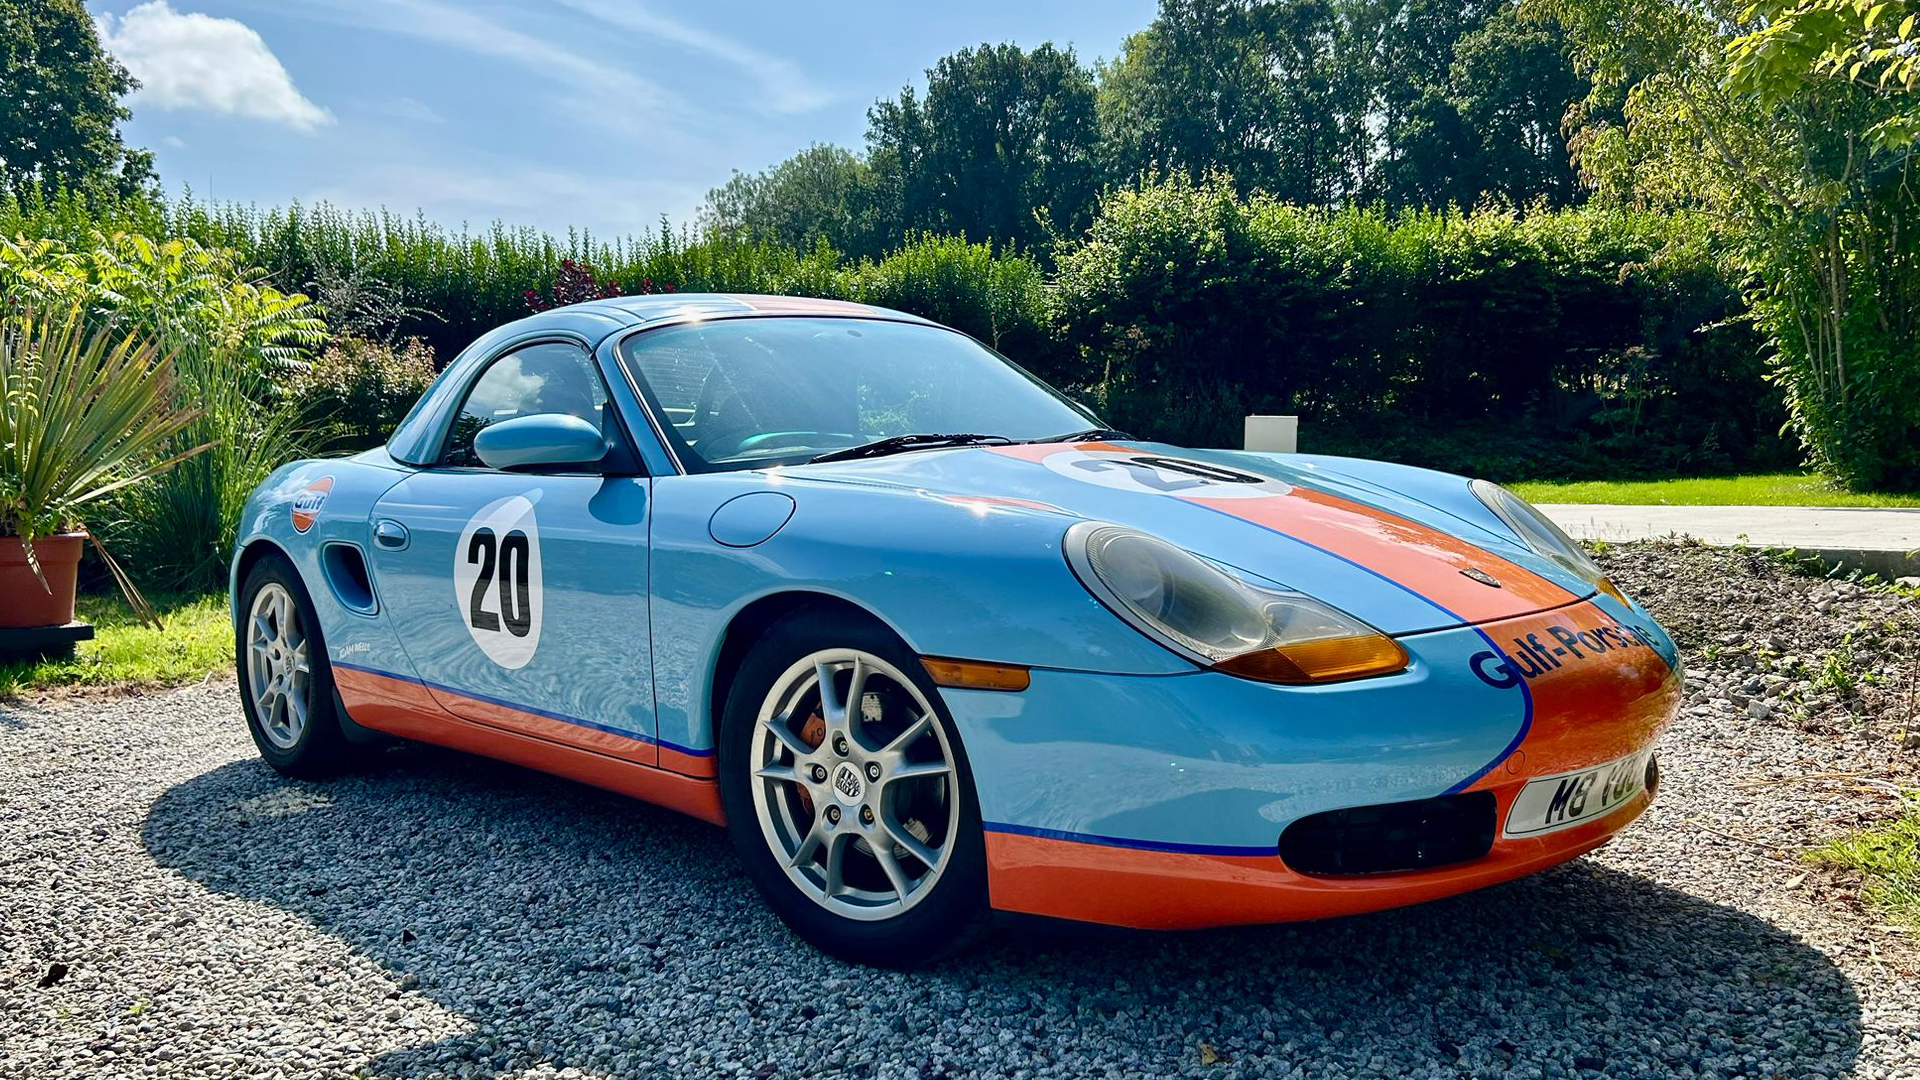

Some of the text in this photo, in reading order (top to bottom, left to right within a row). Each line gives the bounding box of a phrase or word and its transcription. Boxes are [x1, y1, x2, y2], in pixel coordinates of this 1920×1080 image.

[1071, 457, 1265, 492] 20
[295, 494, 325, 510] Gulf
[468, 527, 531, 638] 20
[1469, 624, 1661, 690] Gulf-Porsche
[1544, 772, 1598, 825] M8
